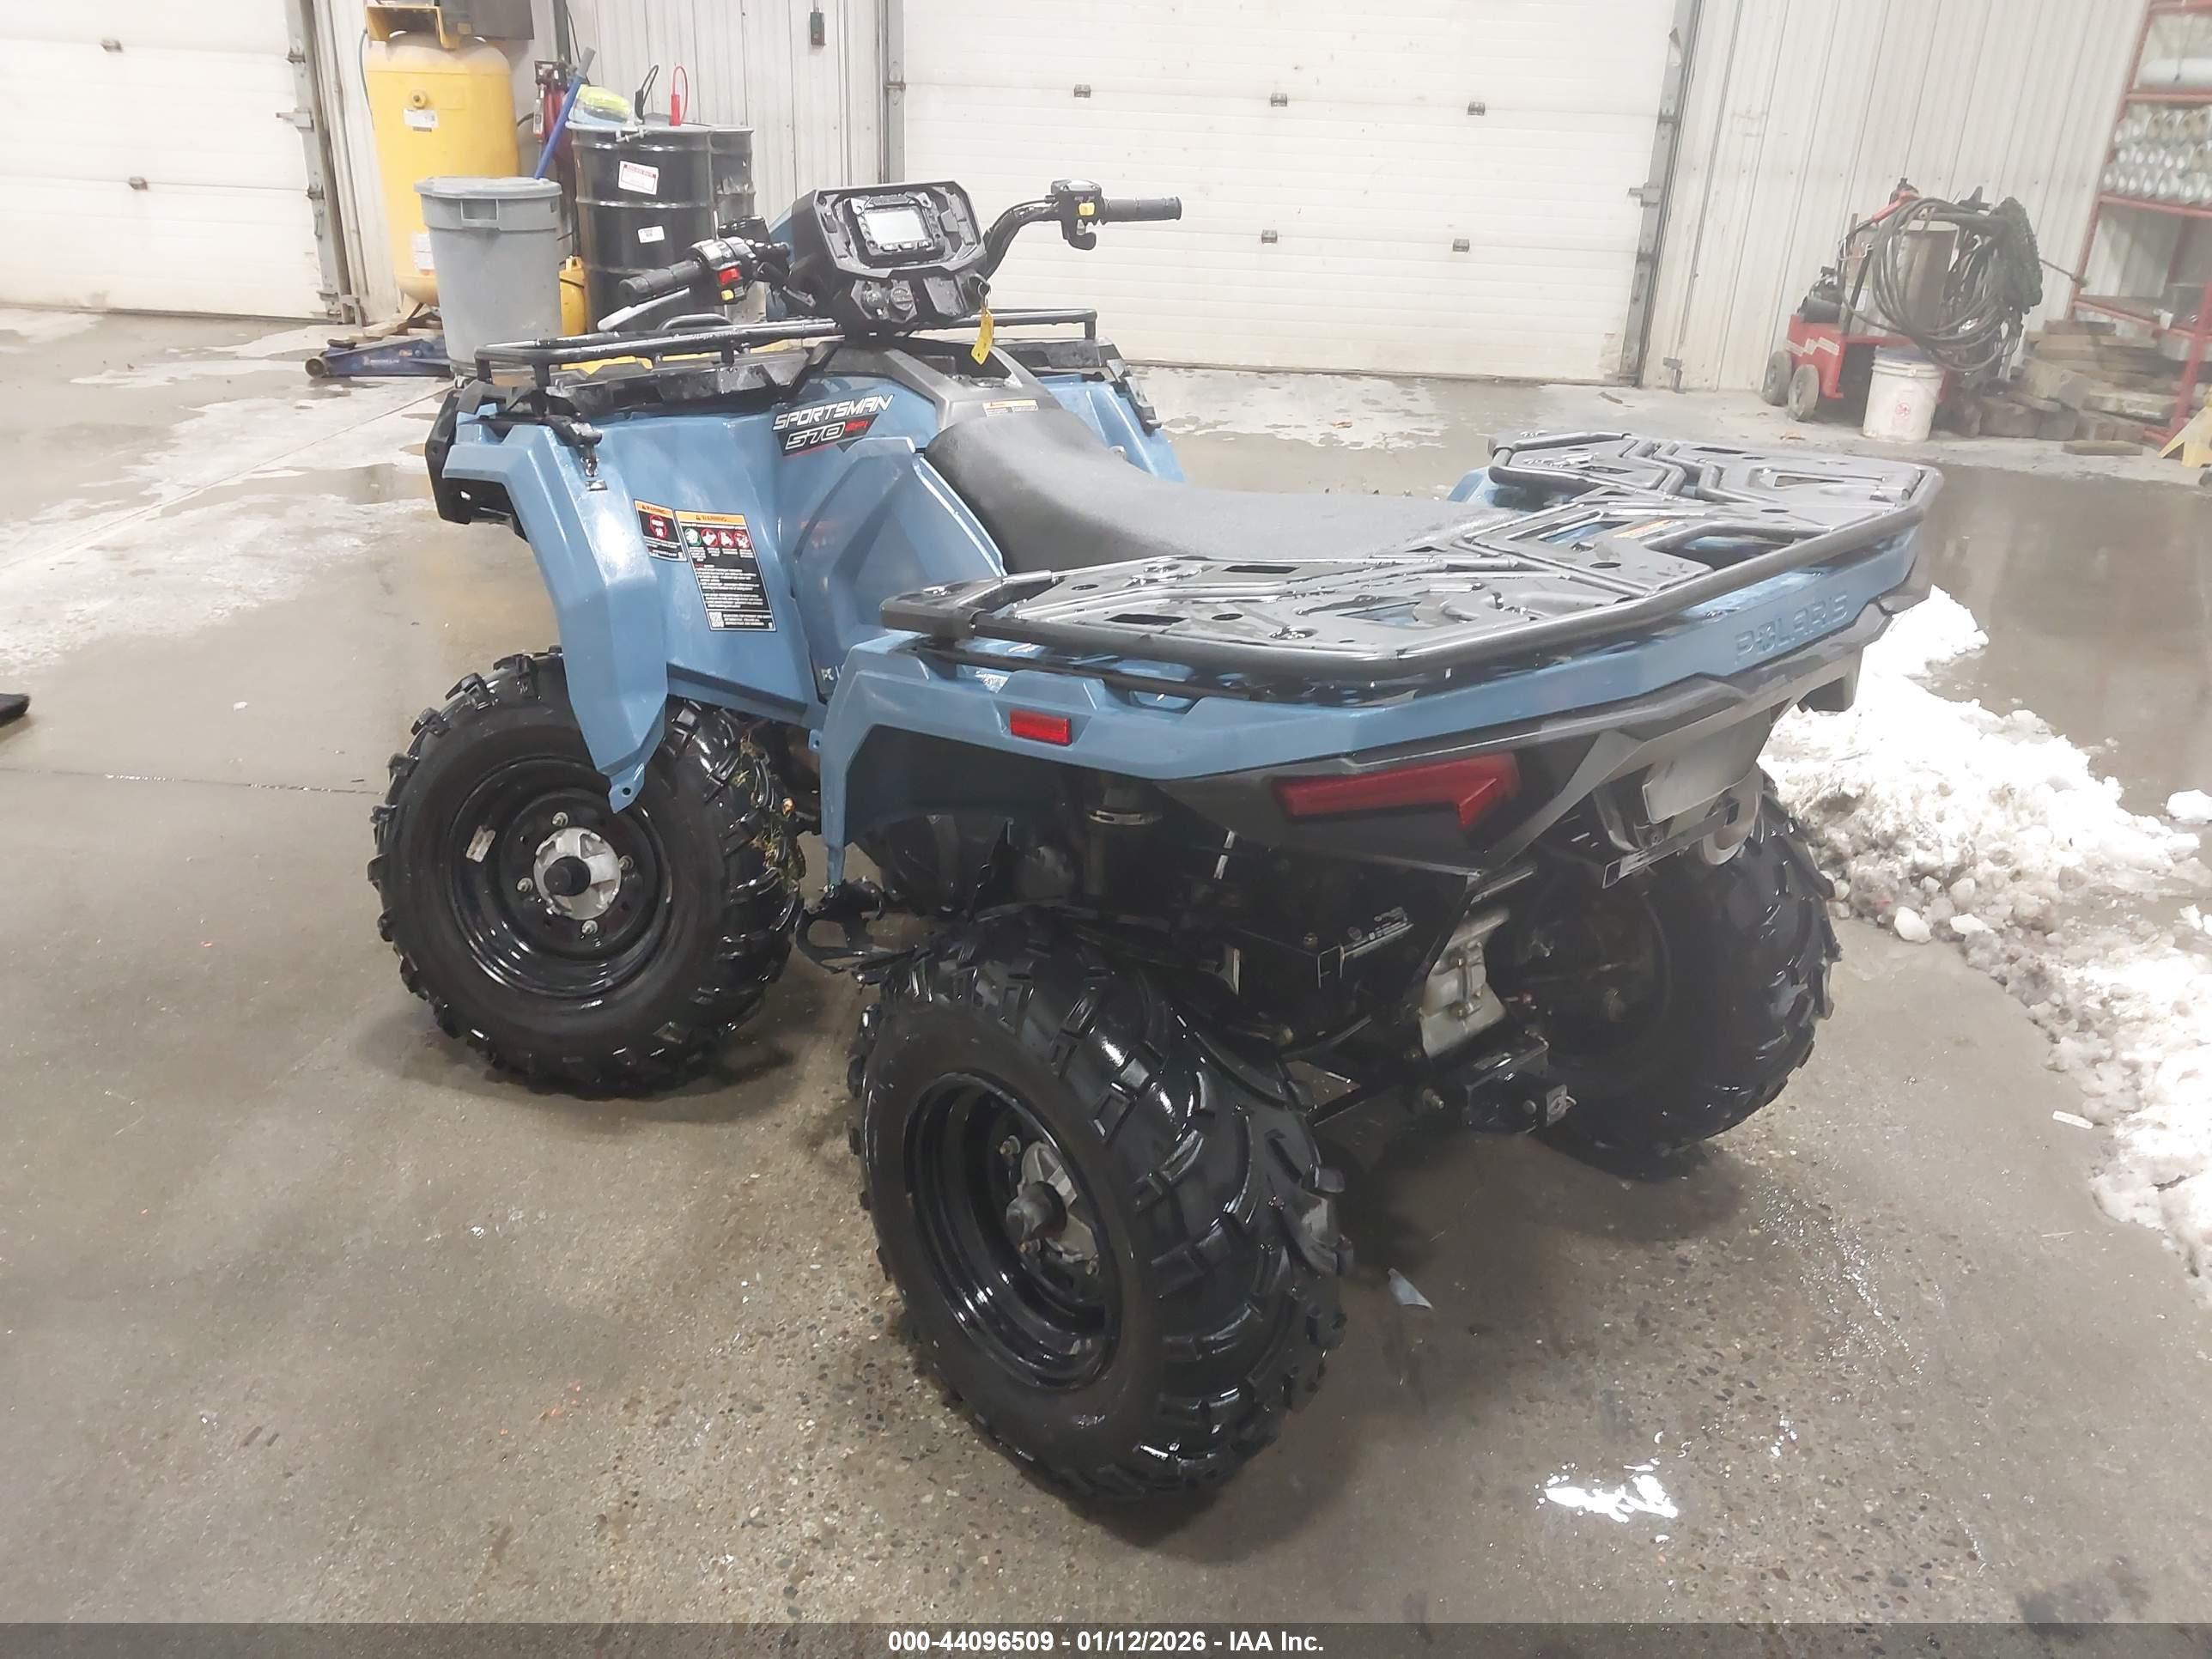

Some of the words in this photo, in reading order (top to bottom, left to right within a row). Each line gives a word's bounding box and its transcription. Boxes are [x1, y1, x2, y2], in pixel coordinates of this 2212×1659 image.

[772, 394, 895, 431] SPORTSMAN
[785, 421, 846, 451] 570
[1734, 592, 1849, 665] POLARIS
